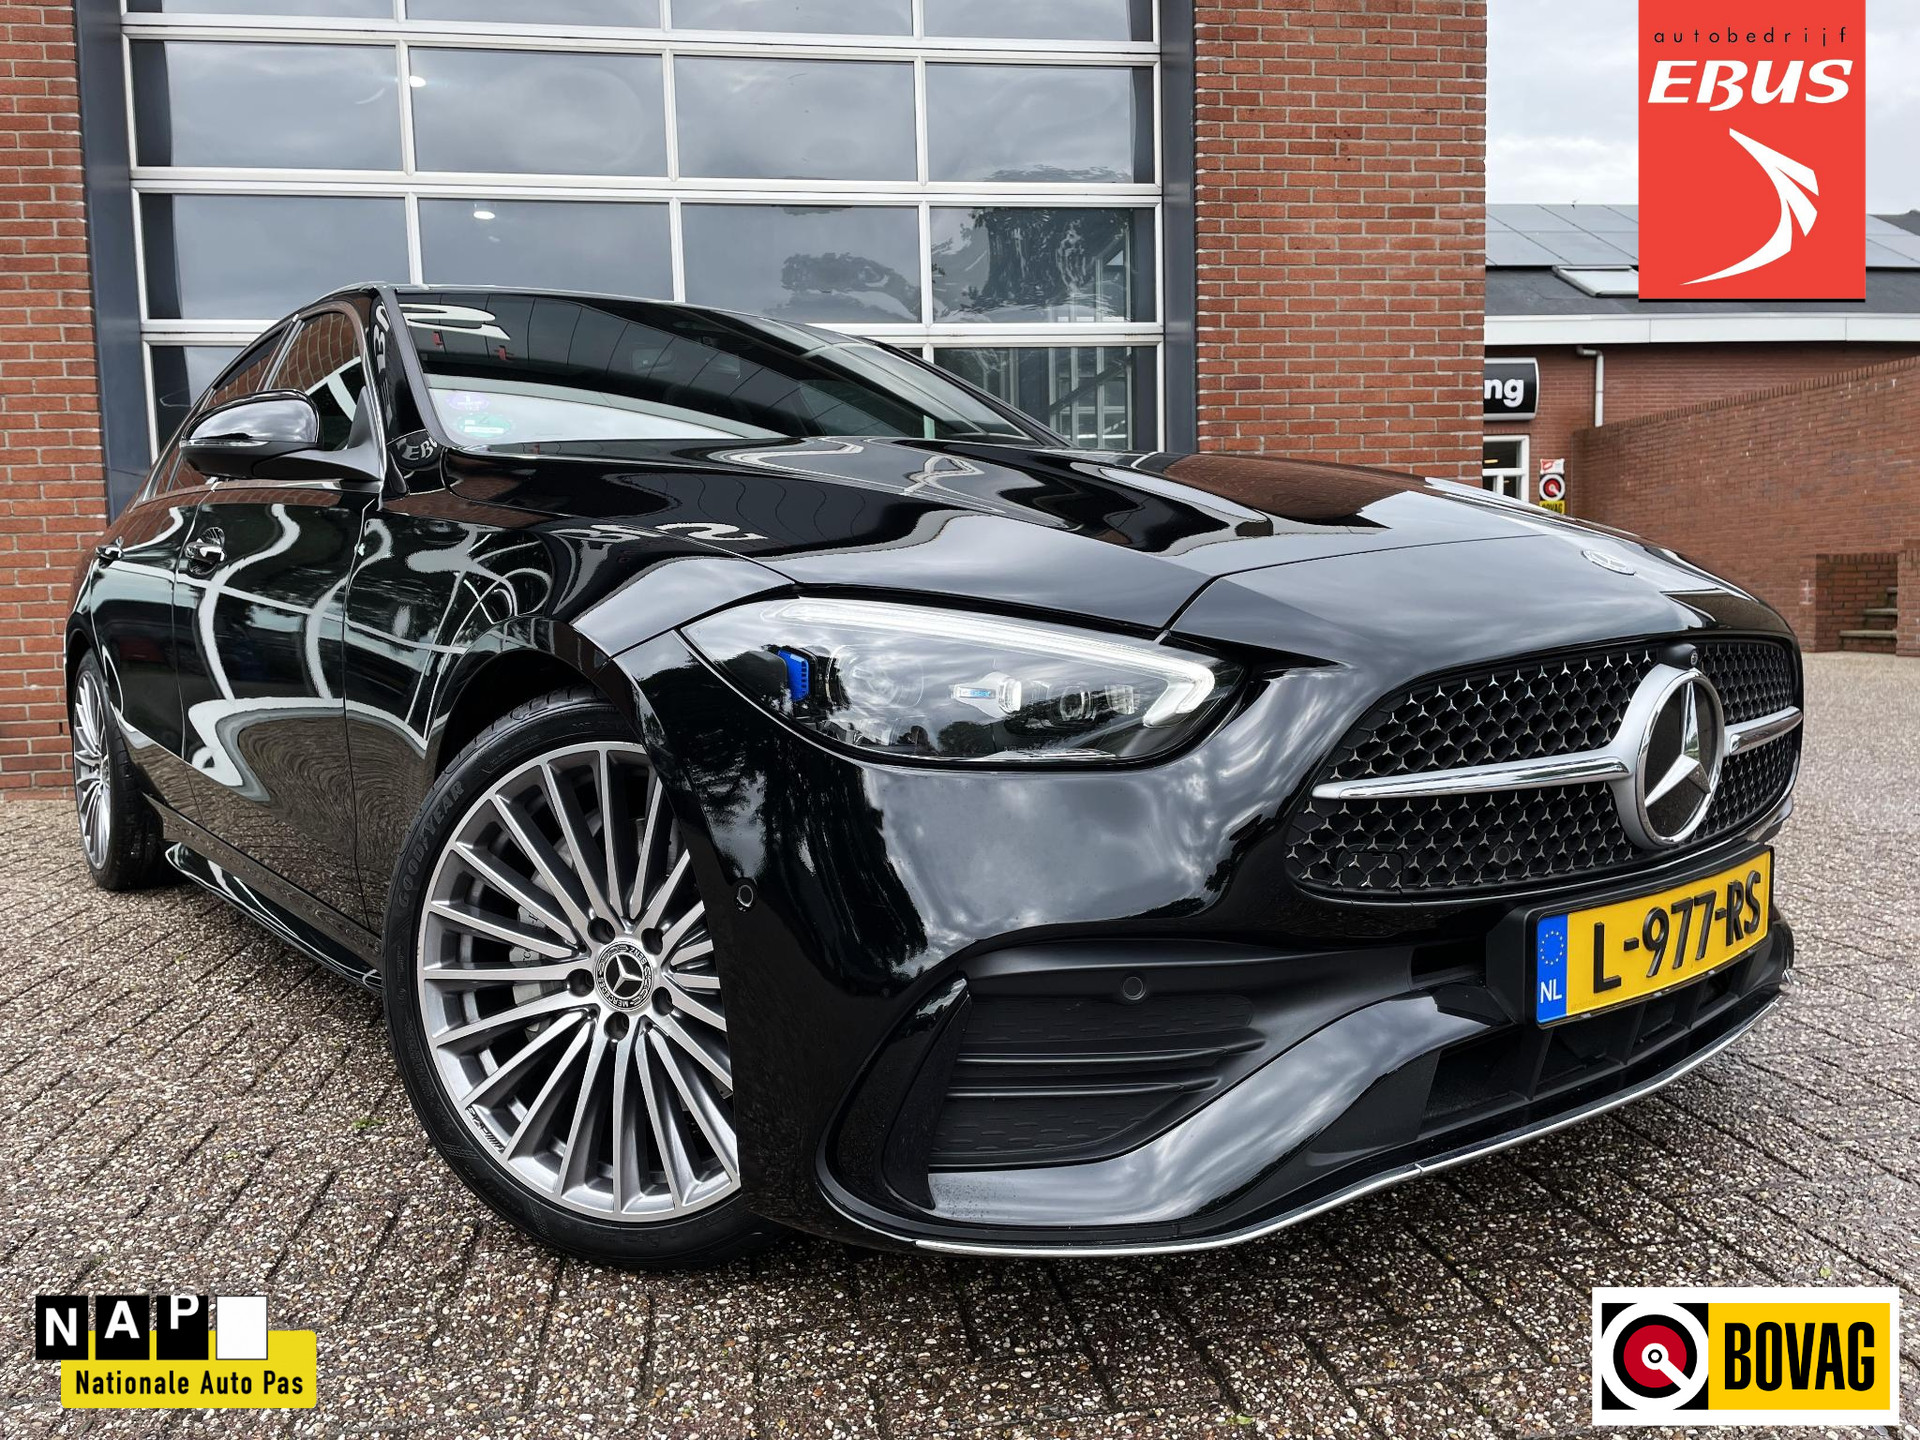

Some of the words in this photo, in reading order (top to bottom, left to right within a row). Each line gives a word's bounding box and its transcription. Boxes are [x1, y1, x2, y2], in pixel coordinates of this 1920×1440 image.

[398, 780, 464, 908] GOODYEAR
[1593, 870, 1761, 994] L-977-RS
[628, 945, 649, 966] BENZ
[597, 976, 630, 1009] MERCEDES
[1540, 979, 1562, 1004] NL
